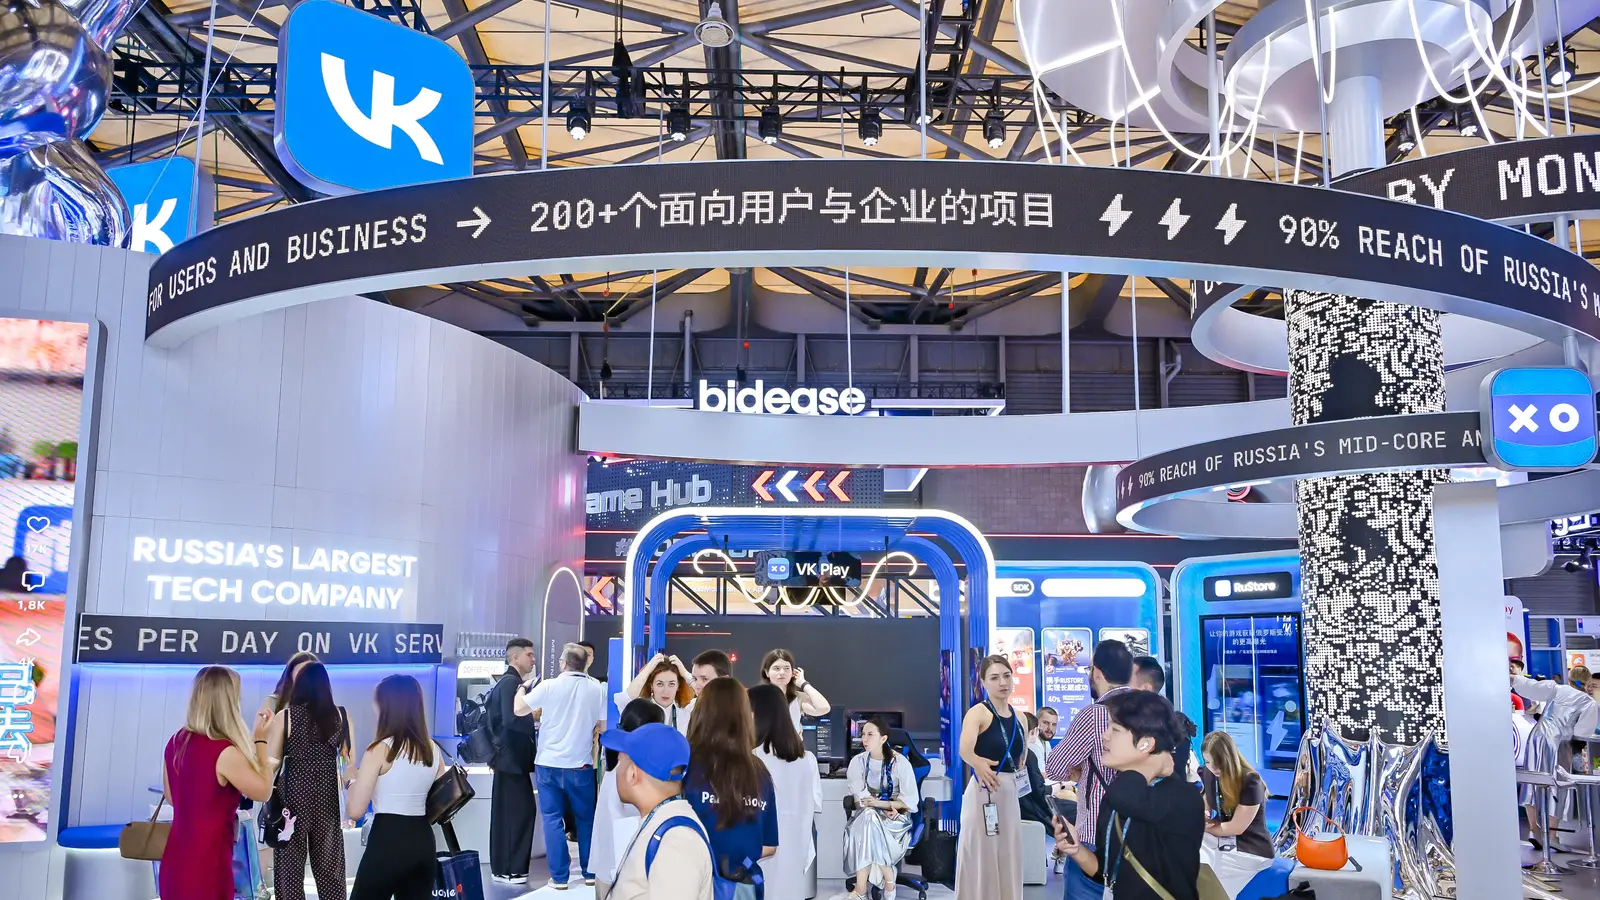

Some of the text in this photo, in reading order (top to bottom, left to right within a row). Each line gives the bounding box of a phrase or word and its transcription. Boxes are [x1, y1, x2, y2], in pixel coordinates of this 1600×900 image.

[1387, 152, 1600, 209] BY MON
[530, 187, 1054, 232] 200+个面向用户与企业的项目
[148, 213, 427, 316] FOR USERS AND BUSINESS
[1279, 214, 1340, 249] 90%
[1359, 226, 1443, 267] REACH
[1460, 244, 1489, 275] OF
[1503, 255, 1588, 310] RUSSIA'S
[699, 379, 866, 416] bidease
[1138, 470, 1155, 489] 90%
[1160, 460, 1197, 482] REACH
[1205, 454, 1223, 473] OF
[1233, 441, 1325, 467] RUSSIA'S
[1339, 431, 1447, 455] MID-CORE
[651, 474, 712, 508] Hub
[133, 536, 417, 577] RUSSIA'S LARGEST
[796, 563, 817, 576] VK
[820, 562, 850, 578] Play
[17, 600, 46, 611] 1,8K
[147, 575, 404, 610] TECH COMPANY
[1234, 581, 1276, 593] RuStore
[138, 628, 199, 653] PER
[221, 630, 279, 654] DAY
[298, 632, 331, 654] ON
[349, 632, 378, 654] VK
